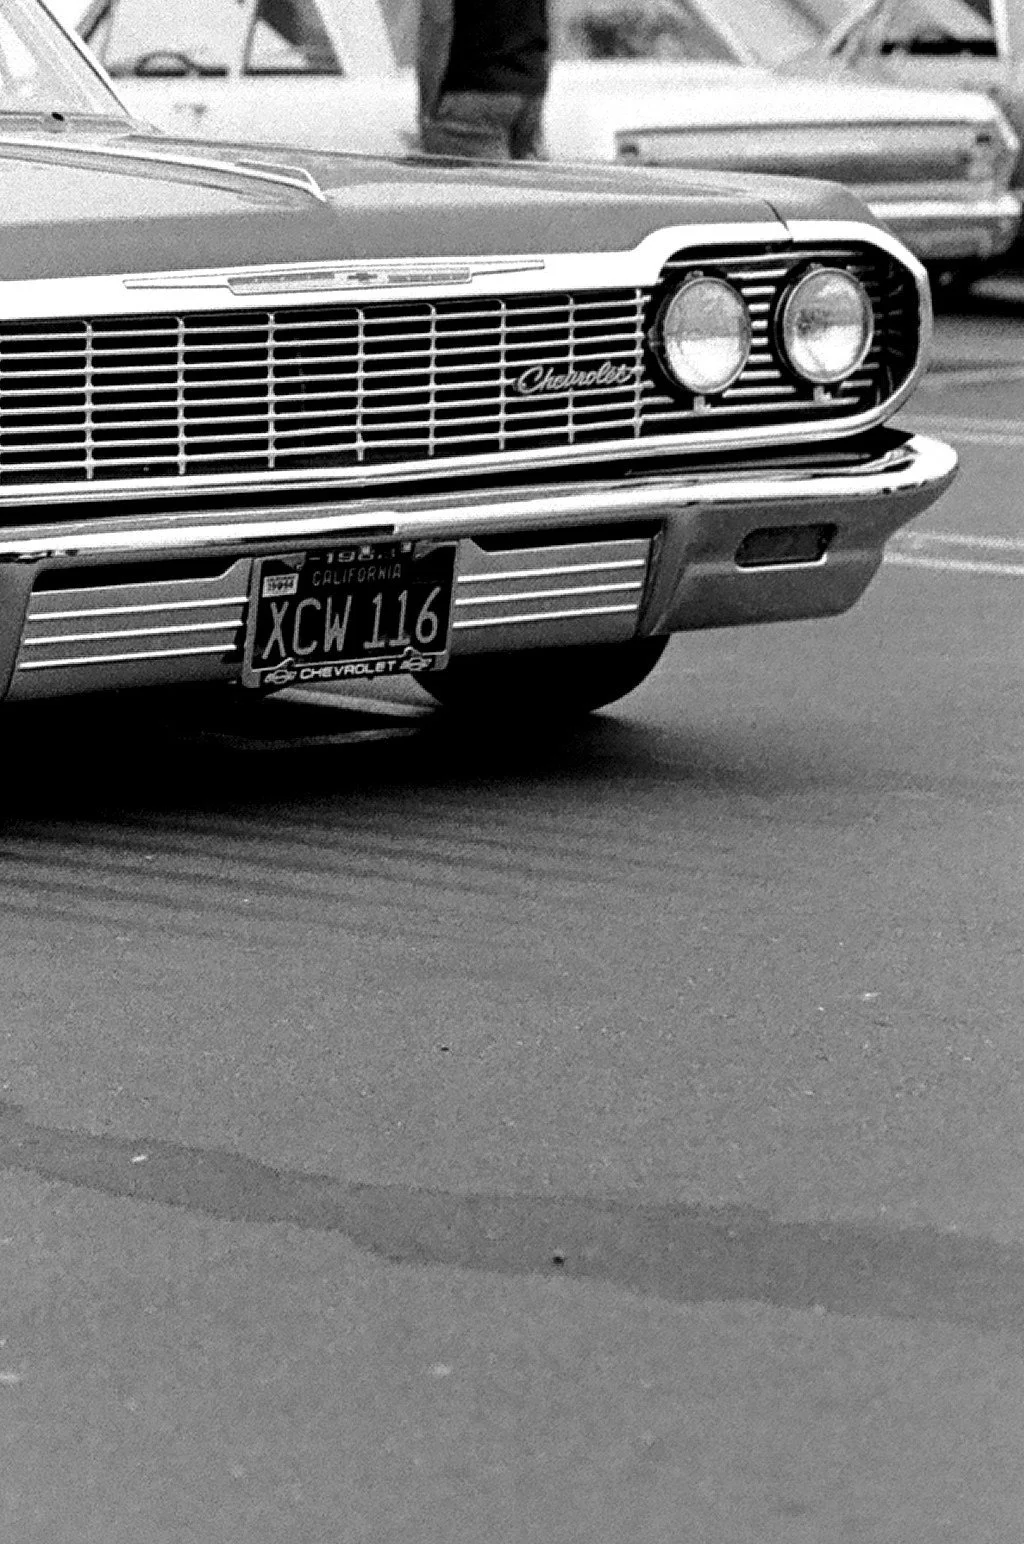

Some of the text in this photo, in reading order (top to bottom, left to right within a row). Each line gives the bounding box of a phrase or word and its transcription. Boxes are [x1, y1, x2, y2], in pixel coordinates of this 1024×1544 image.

[517, 361, 633, 395] Chevrolet
[312, 562, 402, 587] CALIFORNIA
[262, 586, 442, 660] XCW 116
[299, 660, 397, 680] CHEVROLET
